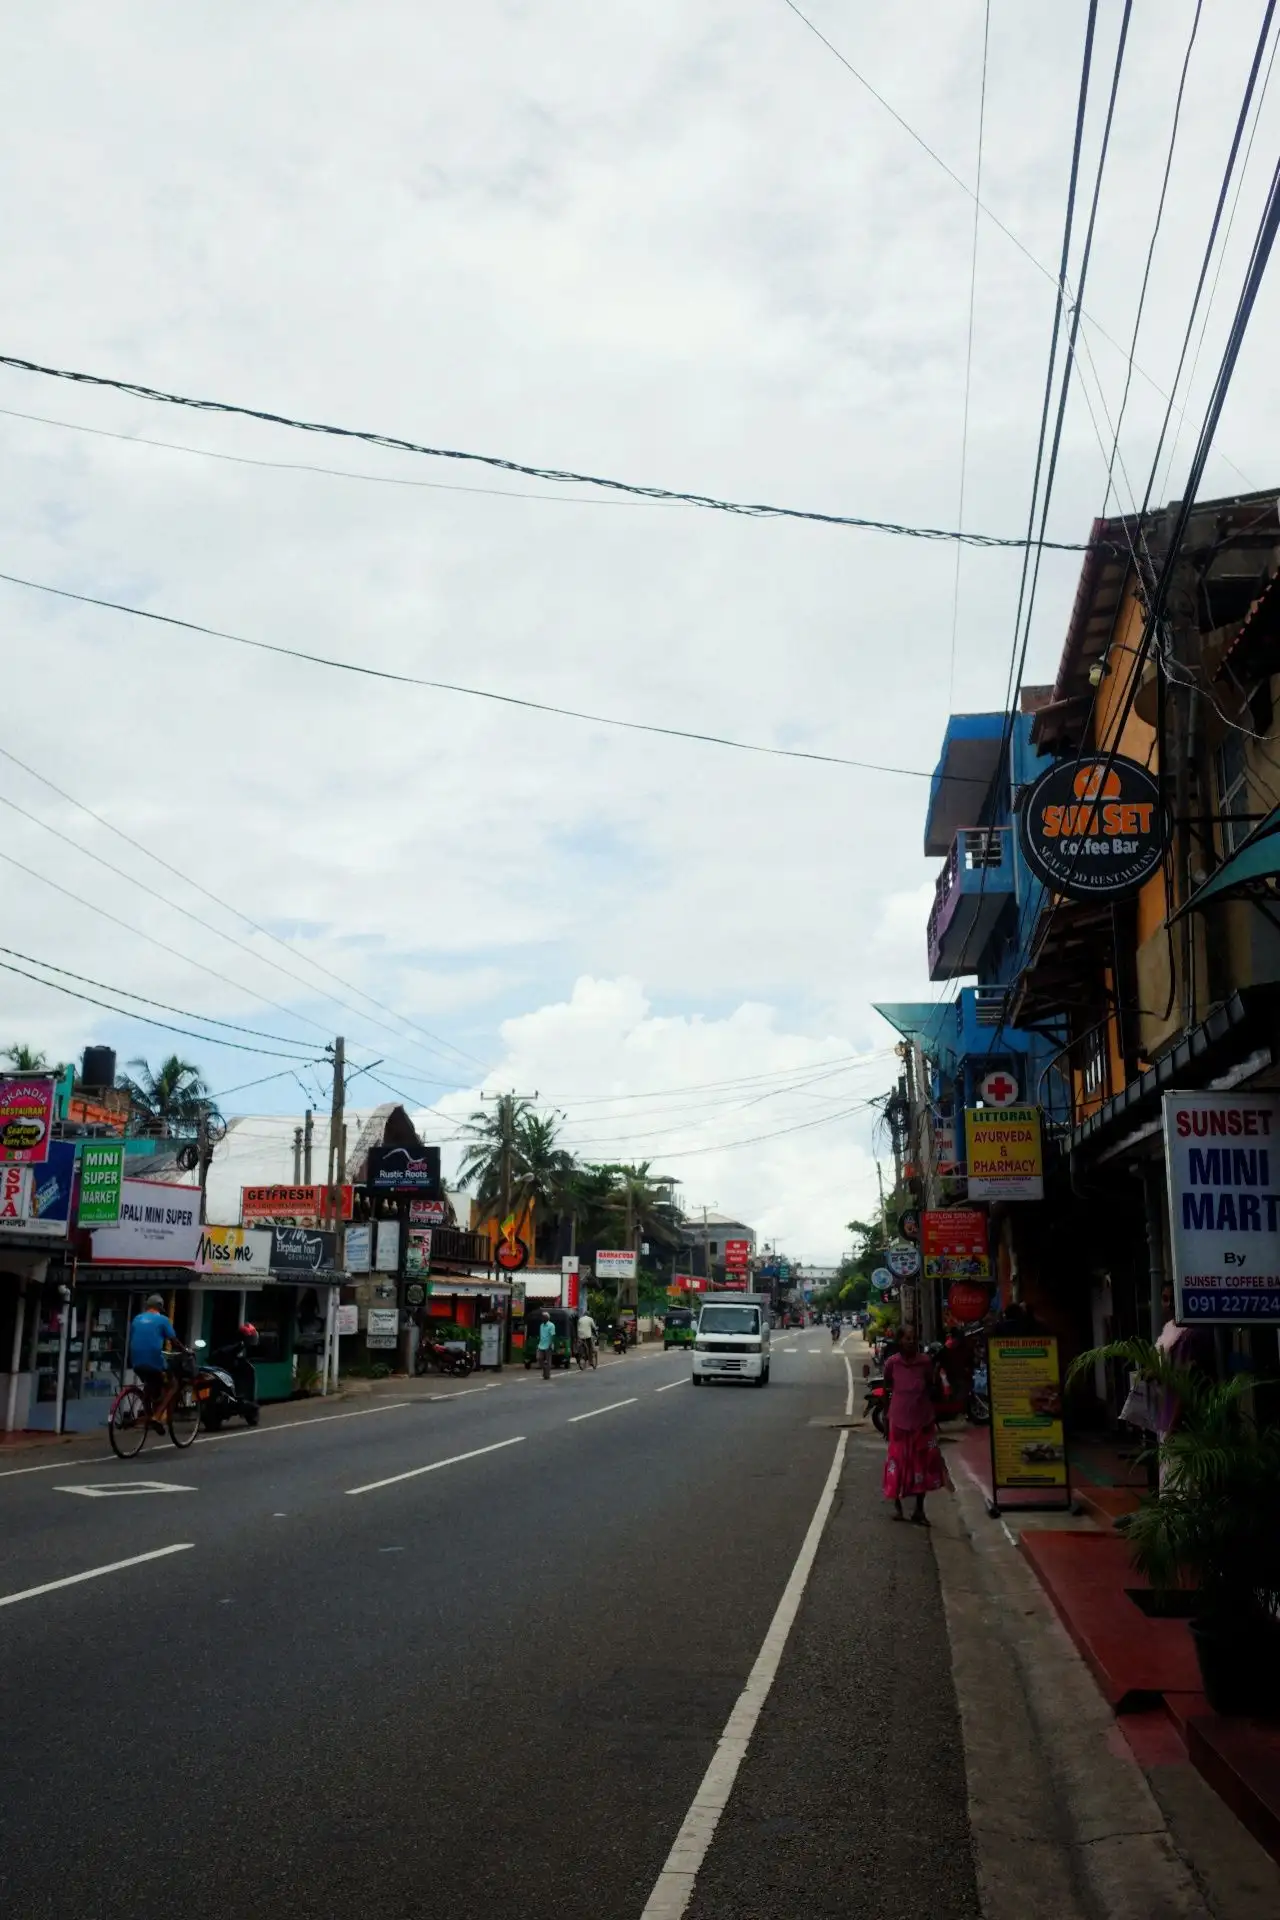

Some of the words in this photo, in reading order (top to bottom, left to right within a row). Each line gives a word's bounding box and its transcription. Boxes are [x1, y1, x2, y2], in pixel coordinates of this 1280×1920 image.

[1060, 838, 1110, 856] Cofee
[1112, 838, 1139, 855] Bar
[1090, 846, 1158, 885] RESTAURANT
[1, 1087, 48, 1107] SKANDIA
[0, 1106, 48, 1116] RESTAURANT
[972, 1111, 1033, 1122] LITTORAL
[1176, 1109, 1273, 1137] SUNSET
[974, 1131, 1033, 1143] AYURVEDA
[1000, 1145, 1008, 1157] &
[86, 1152, 119, 1166] MINI
[973, 1160, 1036, 1173] PHARMACY
[1188, 1147, 1270, 1186] MINI
[84, 1171, 118, 1185] SUPER
[379, 1169, 404, 1179] Rustic
[405, 1169, 428, 1179] Roots
[81, 1190, 117, 1204] MARKET
[412, 1200, 443, 1212] SPA
[1182, 1192, 1280, 1232] MART
[144, 1206, 164, 1224] MINI
[165, 1208, 193, 1227] SUPER
[195, 1231, 231, 1265] Miss
[234, 1244, 254, 1261] me
[1223, 1251, 1247, 1267] By
[1184, 1275, 1223, 1288] SUNSET
[1225, 1275, 1265, 1288] COFFEE
[1188, 1295, 1217, 1313] 091
